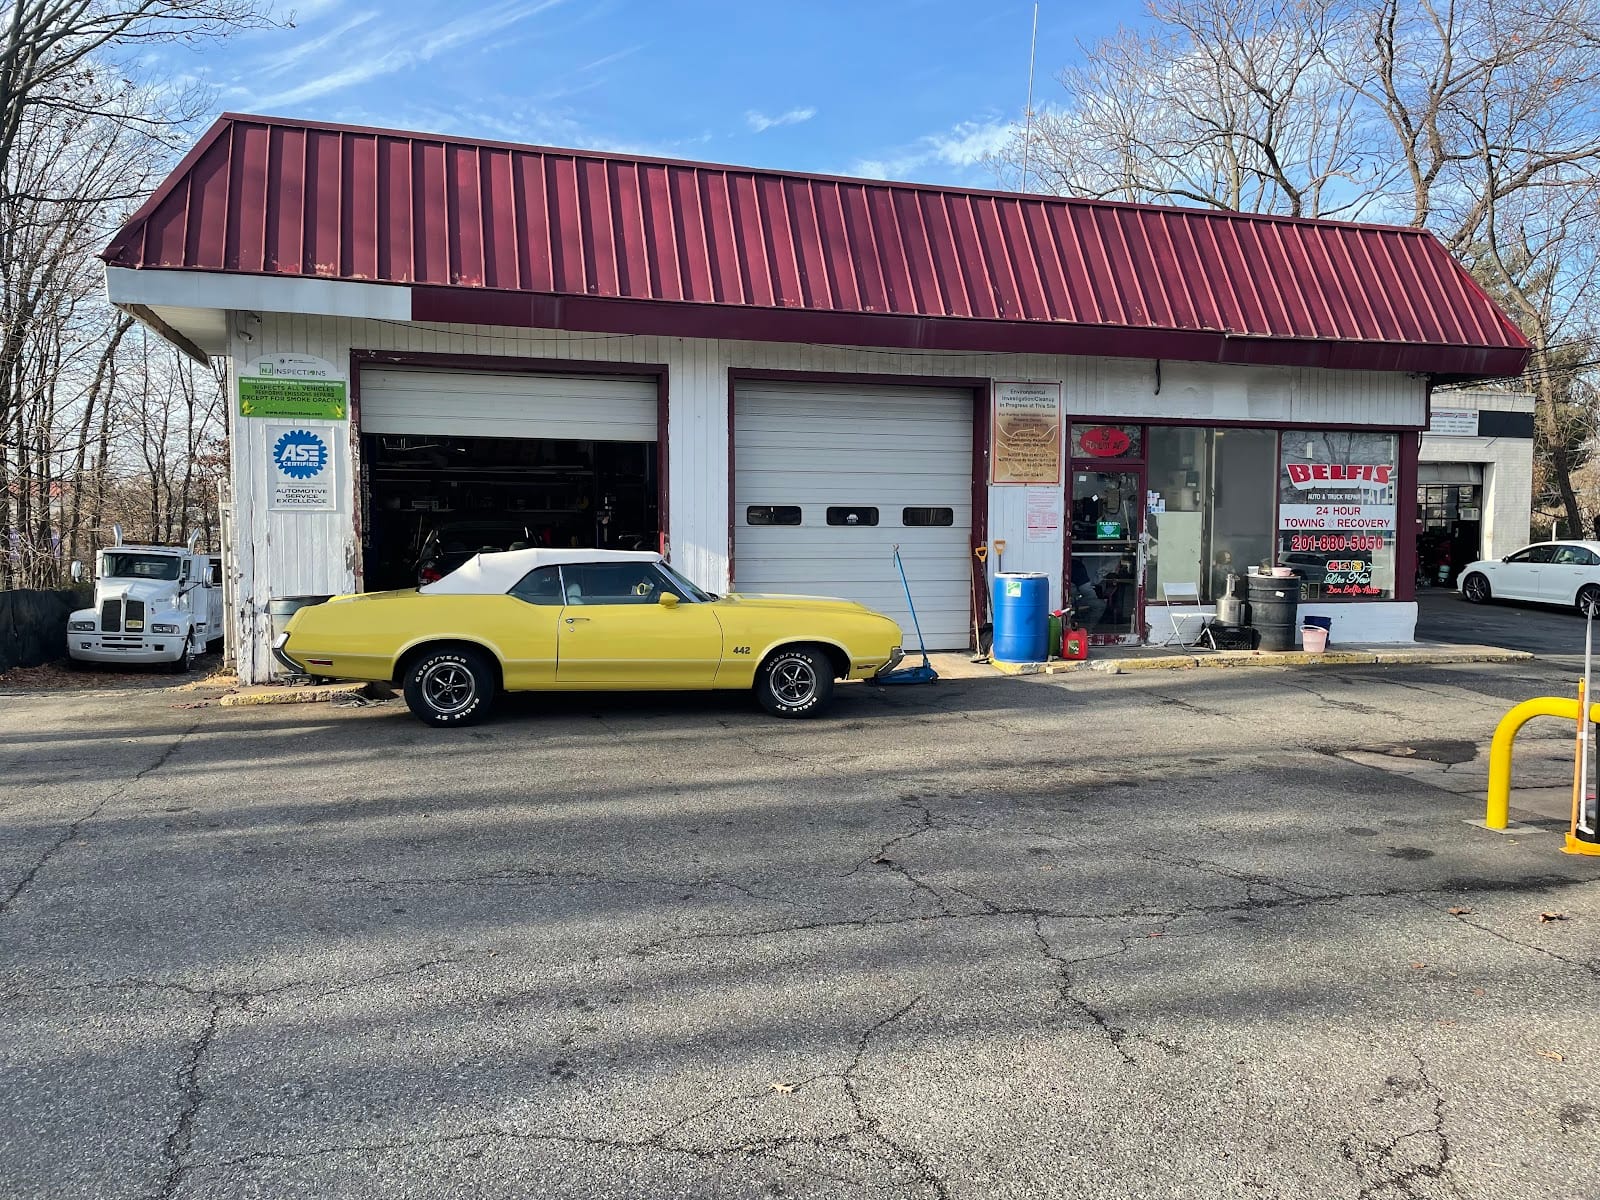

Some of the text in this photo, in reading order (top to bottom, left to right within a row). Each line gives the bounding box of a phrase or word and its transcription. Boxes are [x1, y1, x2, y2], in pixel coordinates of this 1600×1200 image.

[274, 368, 326, 377] INSPECTIONS
[280, 444, 320, 462] ASE
[1316, 506, 1361, 516] 24 HOUR
[1285, 519, 1325, 528] TOWING
[1337, 518, 1391, 528] RECOVERY
[1291, 534, 1384, 552] 201-880-5050
[733, 646, 751, 655] 442
[415, 655, 467, 683] GOODYEAR
[766, 652, 813, 672] GOODYEAR
